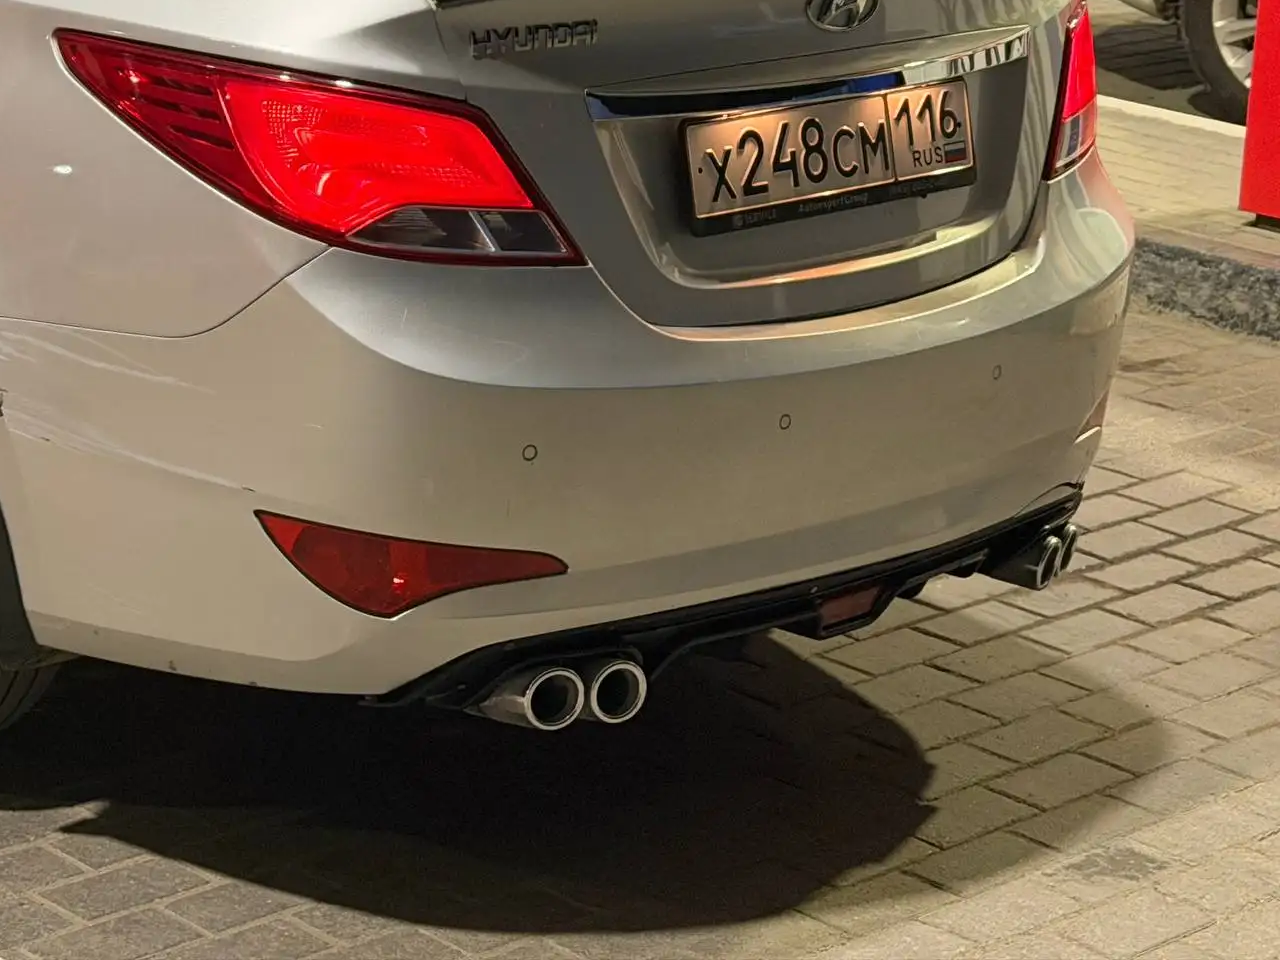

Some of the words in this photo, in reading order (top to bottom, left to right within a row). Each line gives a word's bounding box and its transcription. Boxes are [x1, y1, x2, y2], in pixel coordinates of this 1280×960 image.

[471, 19, 598, 58] HYUNDAI
[893, 90, 959, 146] 116
[913, 147, 944, 168] RUS
